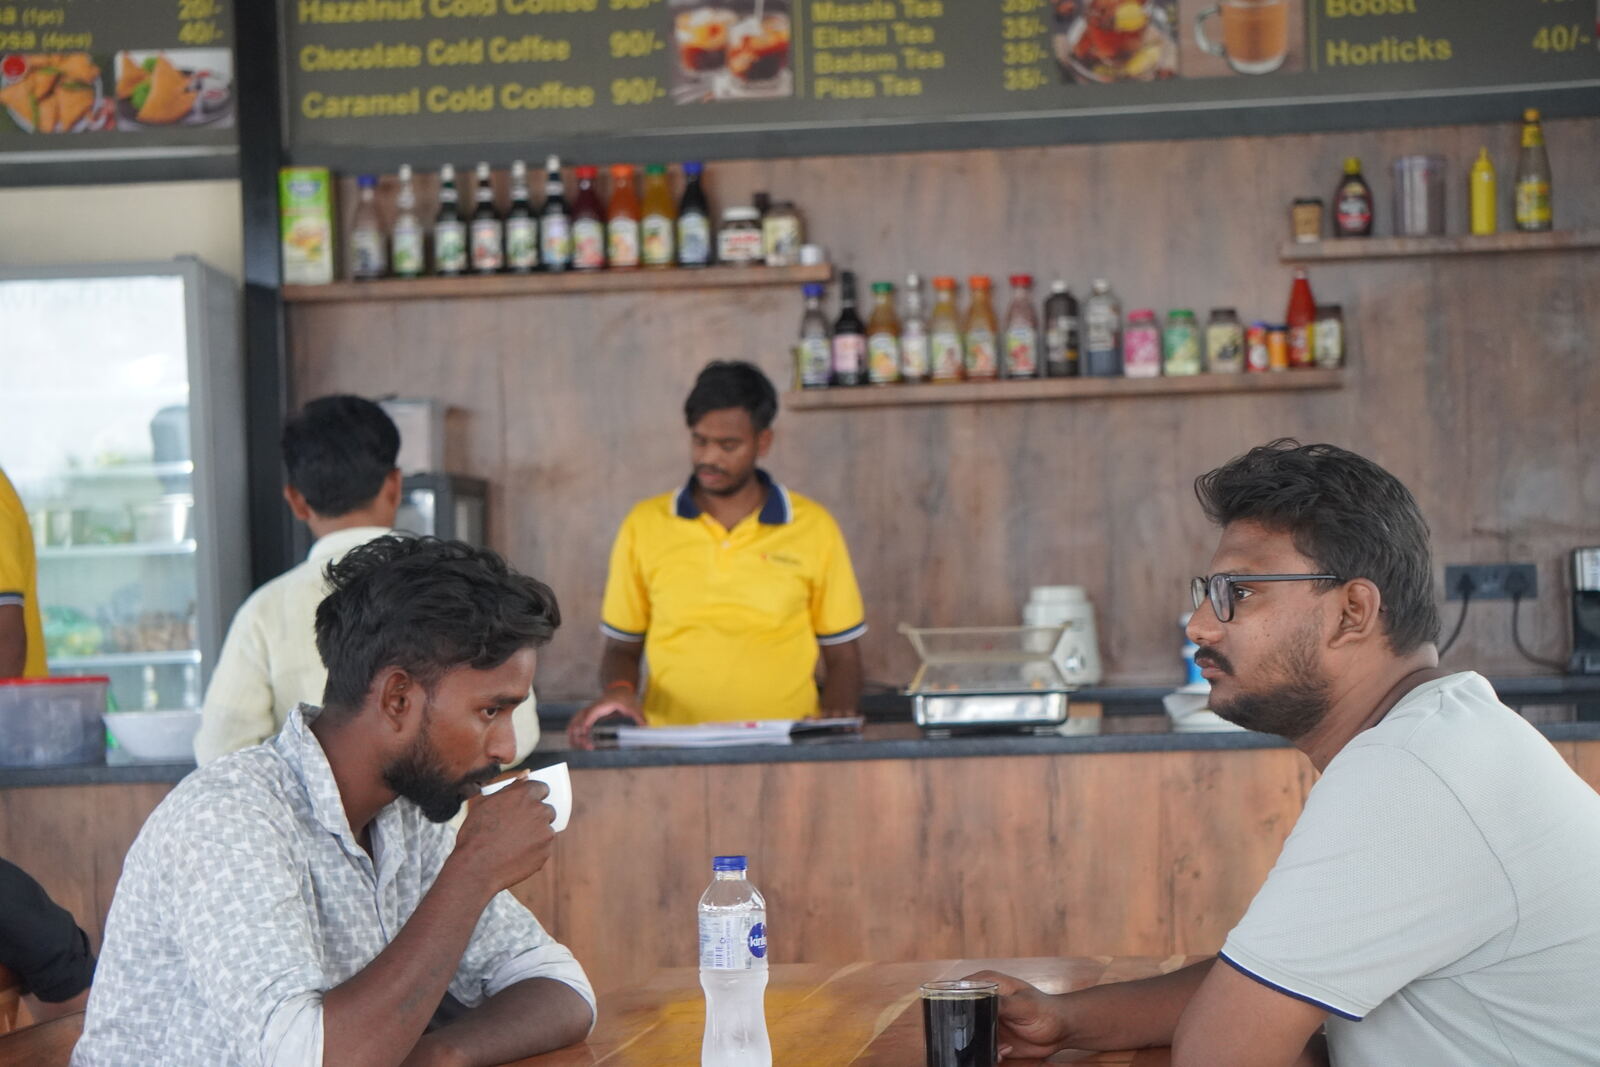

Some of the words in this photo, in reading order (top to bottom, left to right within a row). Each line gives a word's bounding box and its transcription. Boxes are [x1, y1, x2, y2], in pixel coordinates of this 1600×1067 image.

[299, 0, 423, 23] Hazelnut
[892, 22, 935, 44] Tea
[300, 43, 422, 71] Chocolate
[426, 38, 483, 66] Cold
[489, 35, 571, 63] Coffee
[609, 29, 665, 58] 90/-
[1325, 36, 1452, 65] Horlicks
[1533, 25, 1591, 51] 40/-
[902, 47, 944, 68] Tea
[880, 74, 922, 96] Tea
[302, 89, 420, 118] Caramel
[427, 85, 494, 112] Cold
[501, 81, 595, 109] Coffee
[610, 77, 665, 104] 90/-
